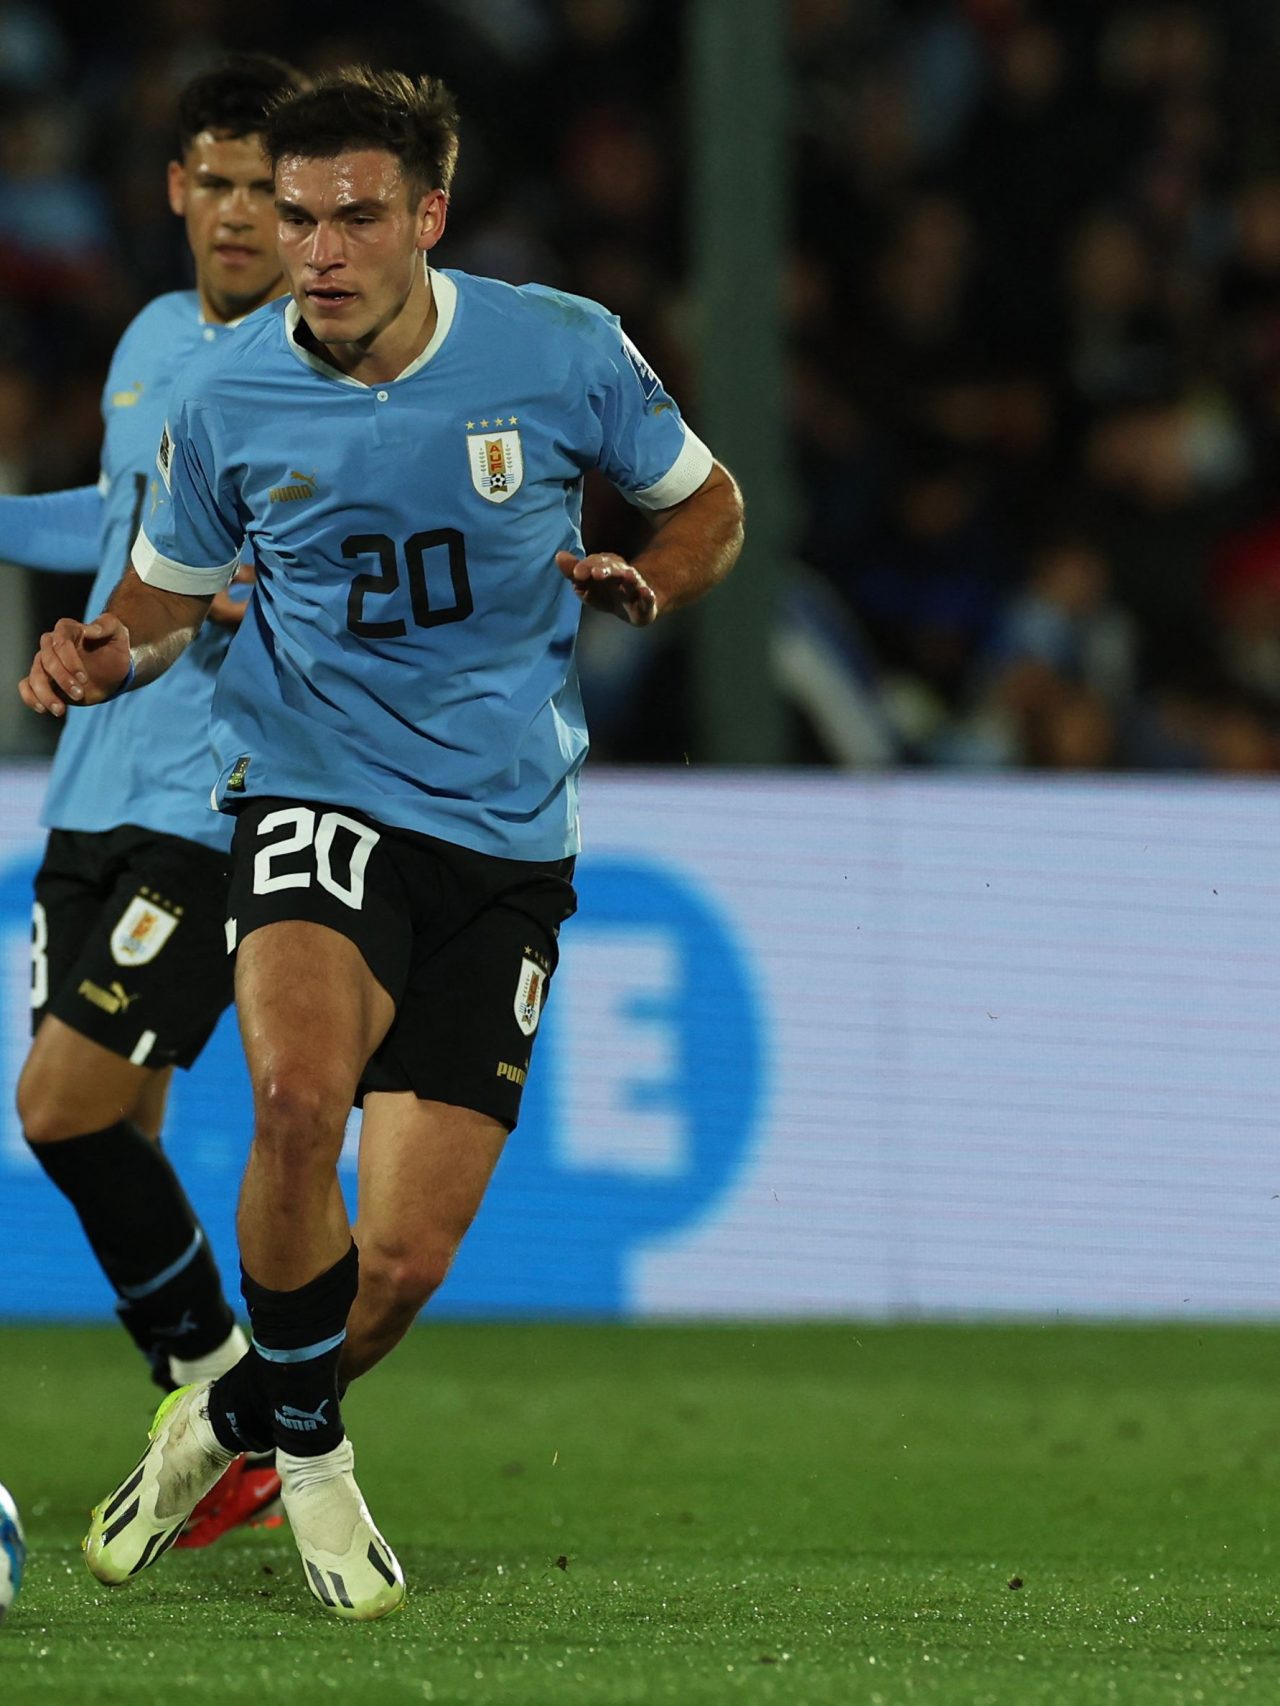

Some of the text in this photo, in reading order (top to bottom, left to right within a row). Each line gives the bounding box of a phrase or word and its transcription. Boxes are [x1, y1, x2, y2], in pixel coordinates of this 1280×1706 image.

[489, 445, 502, 472] AUF
[340, 527, 474, 639] 20
[253, 806, 381, 910] 20
[497, 1061, 526, 1088] PUM
[275, 1408, 318, 1431] PUMA
